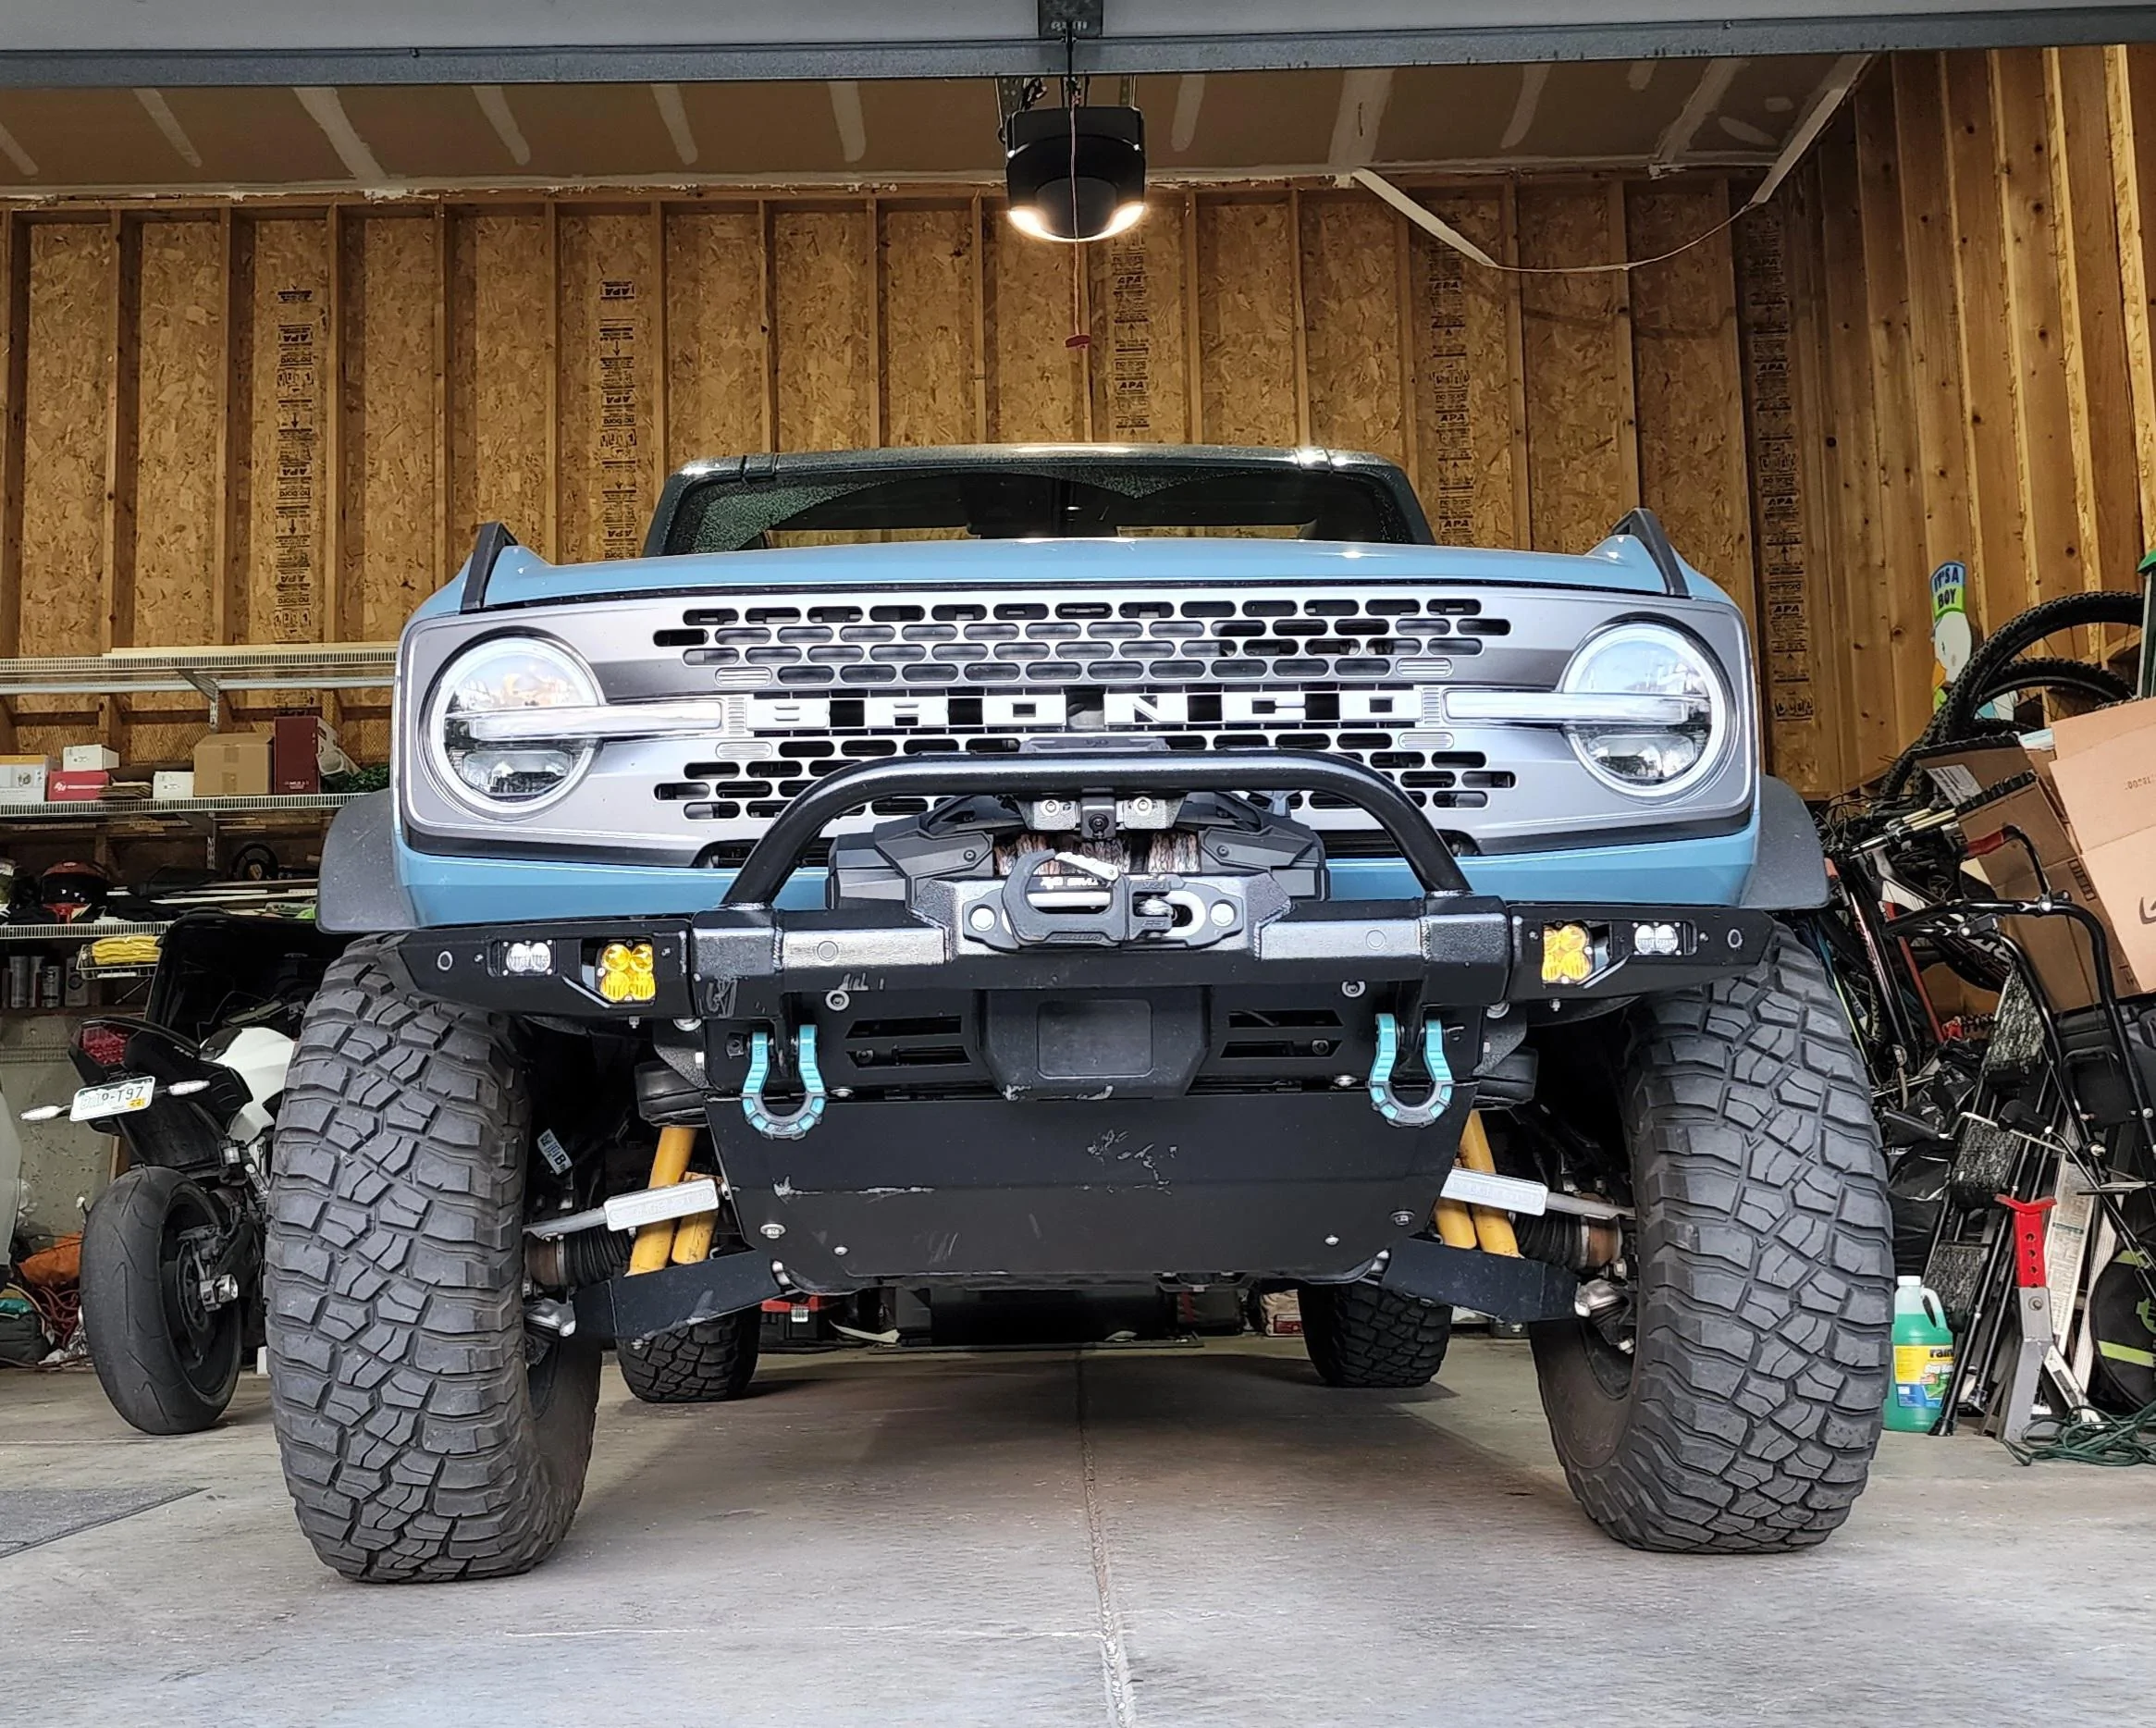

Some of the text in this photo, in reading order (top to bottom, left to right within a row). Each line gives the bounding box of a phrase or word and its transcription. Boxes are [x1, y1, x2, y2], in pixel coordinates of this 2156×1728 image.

[604, 288, 630, 296] APA
[283, 334, 309, 343] APA
[1120, 381, 1144, 389] APA
[606, 395, 631, 404] APA
[1441, 413, 1465, 422] APA
[282, 468, 308, 476] APA
[1768, 497, 1793, 505] APA
[1444, 520, 1470, 528] APA
[281, 574, 306, 583] APA
[1951, 566, 1960, 584] A
[1938, 588, 1956, 610] BOY
[1774, 605, 1800, 613] APA
[745, 690, 1423, 731] BRONCO
